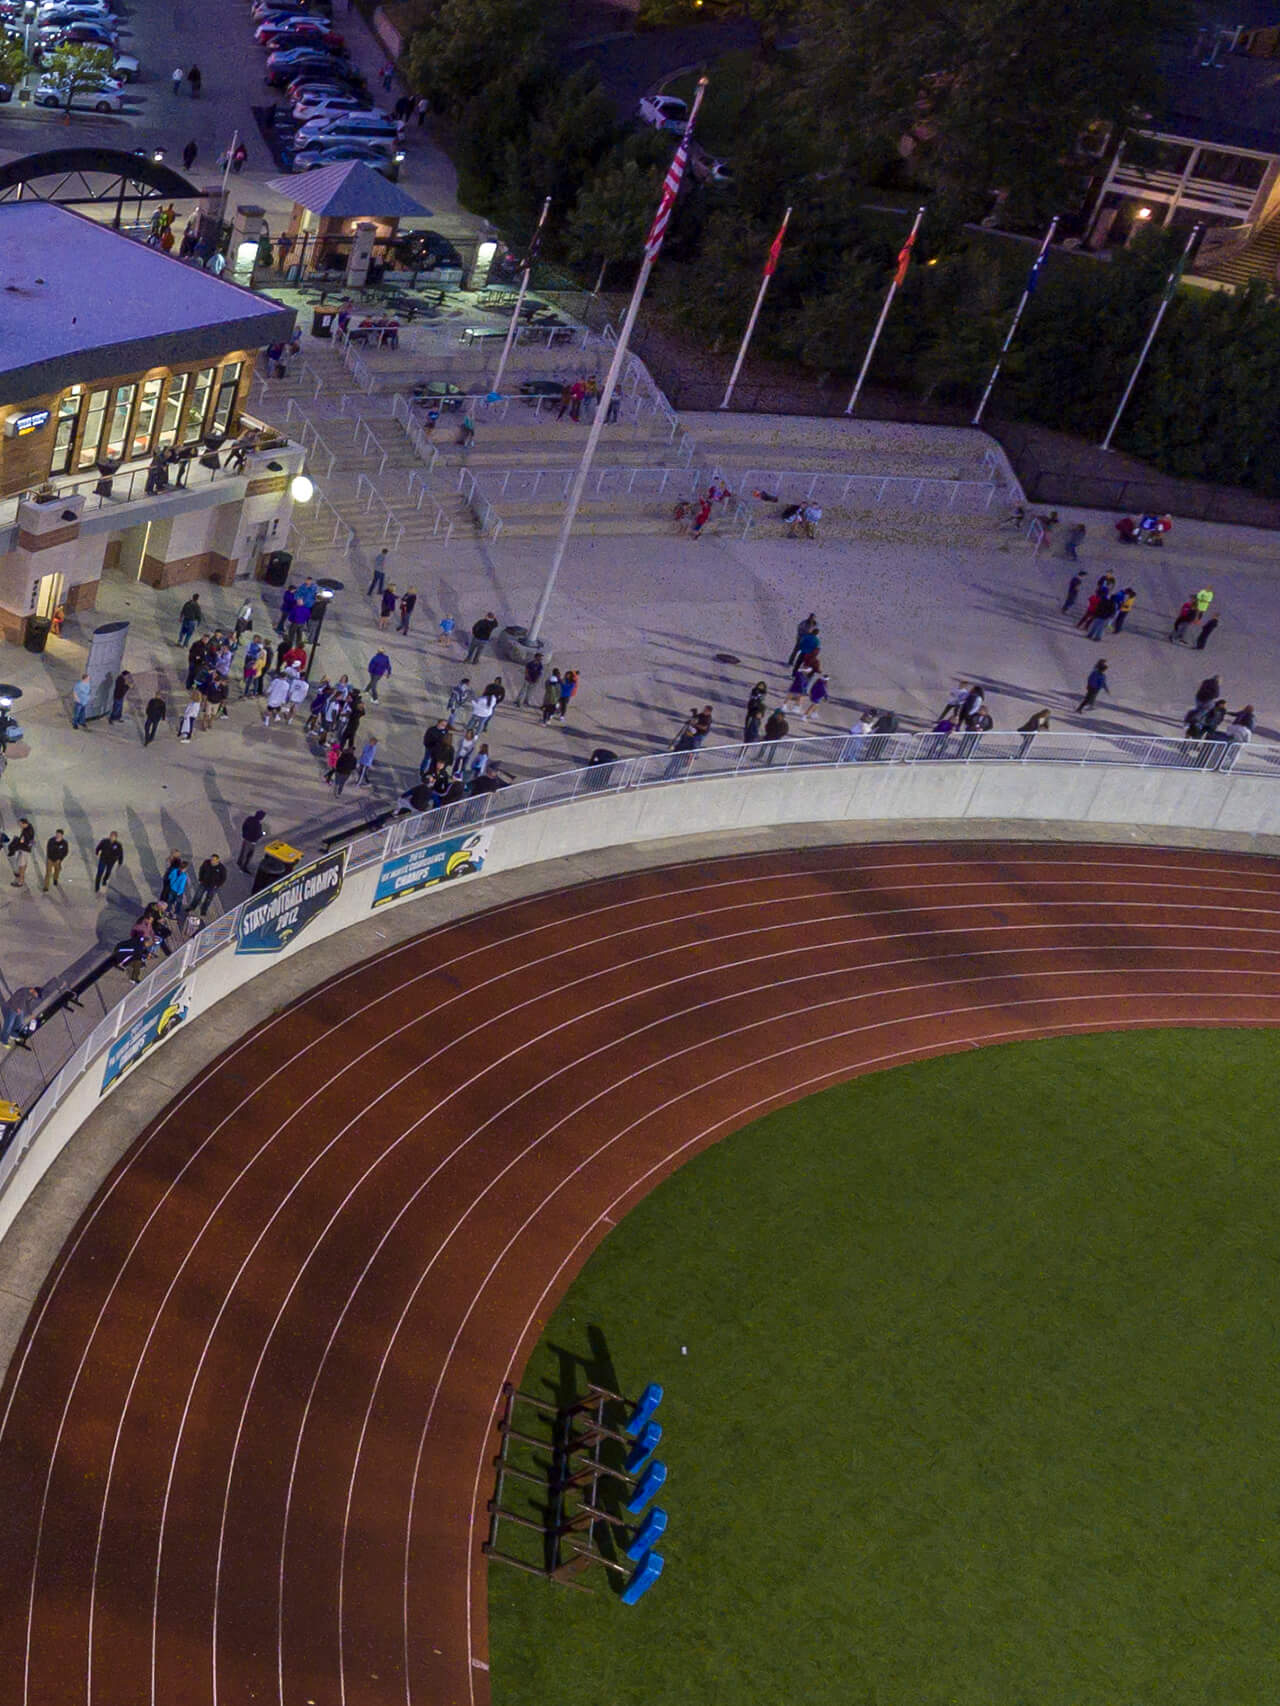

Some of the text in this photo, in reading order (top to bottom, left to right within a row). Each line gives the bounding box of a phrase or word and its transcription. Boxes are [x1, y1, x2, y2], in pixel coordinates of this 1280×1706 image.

[243, 865, 340, 936] STATE FOOTBALL CHAMPS
[394, 866, 431, 889] CHAMPS
